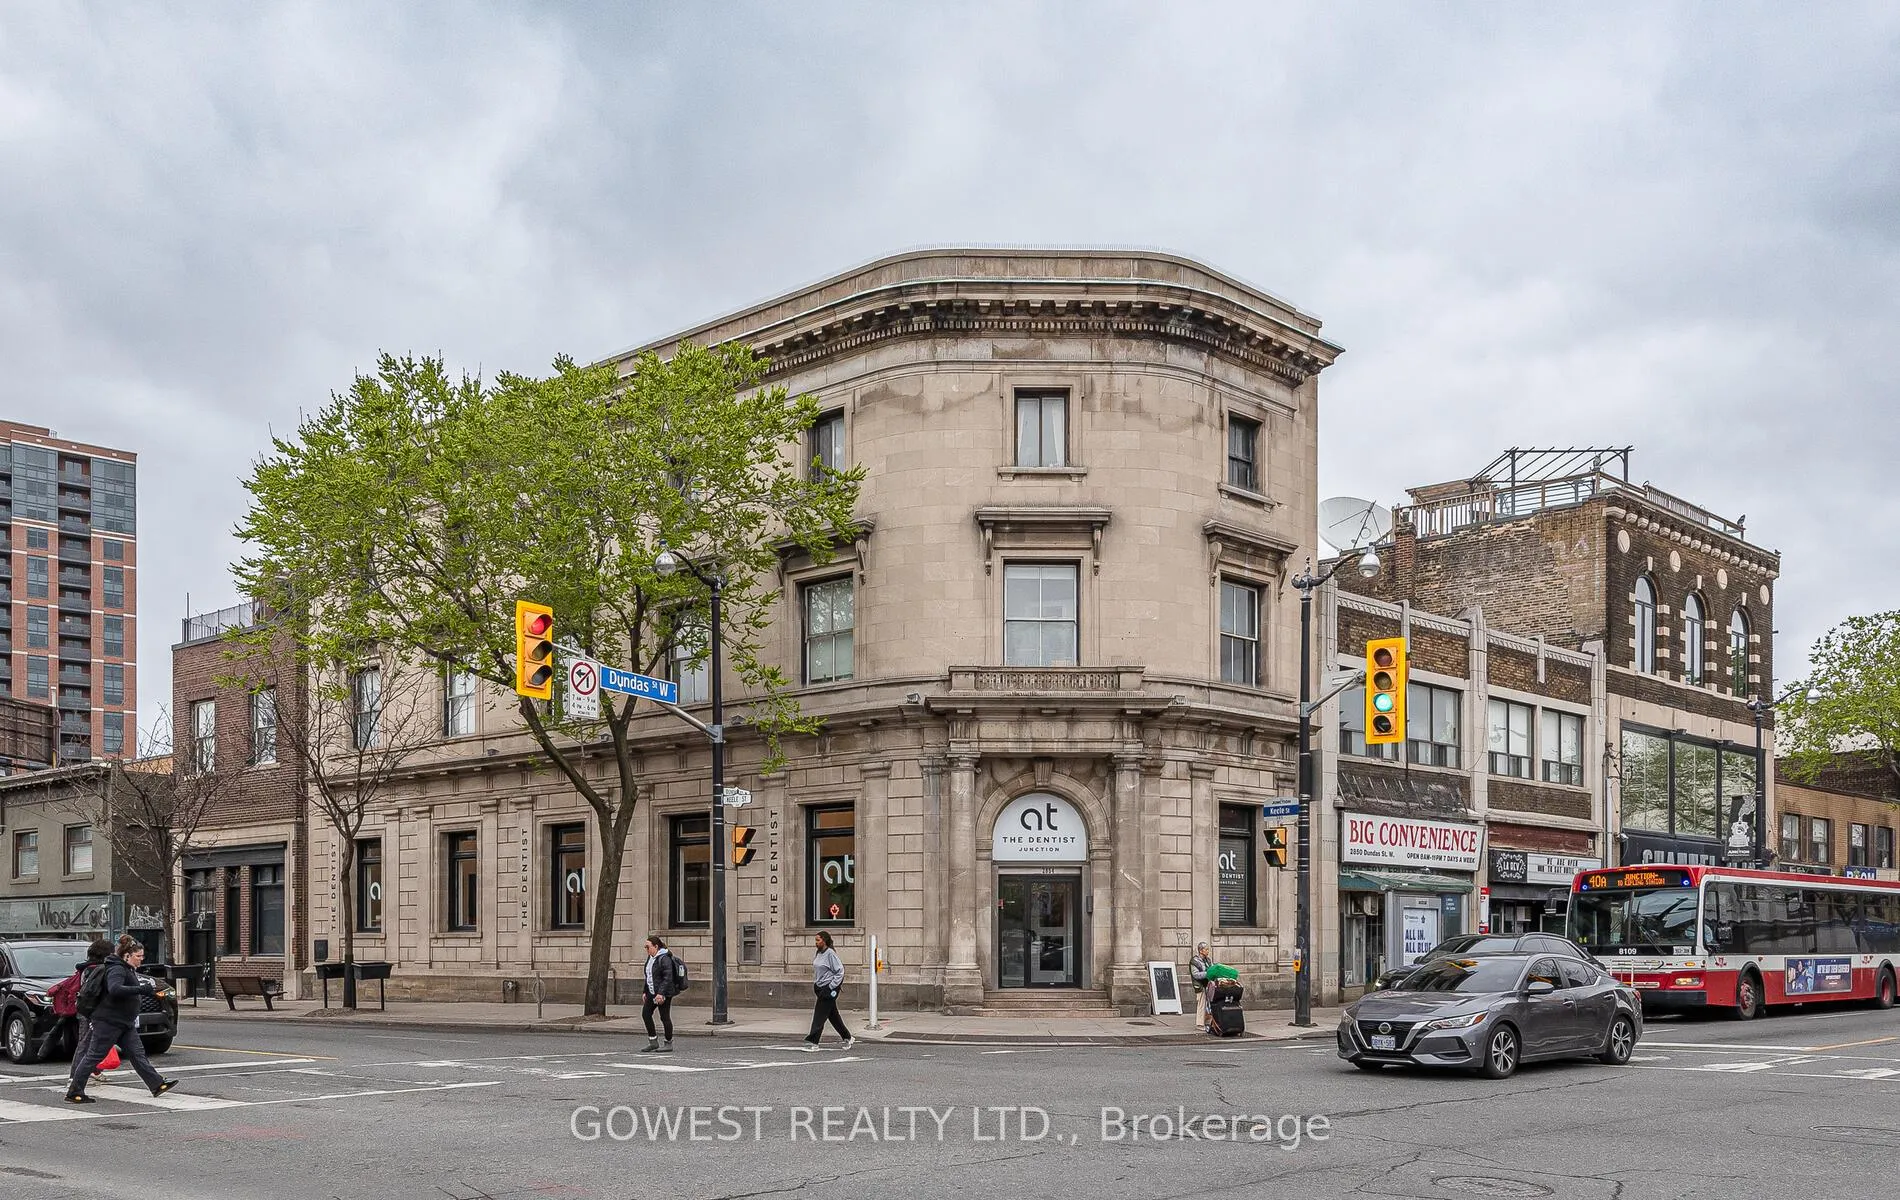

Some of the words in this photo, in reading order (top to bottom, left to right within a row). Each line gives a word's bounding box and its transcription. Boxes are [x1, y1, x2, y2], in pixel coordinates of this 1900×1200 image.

[609, 670, 649, 693] Dundas
[651, 680, 658, 689] St
[659, 682, 669, 697] W
[1270, 807, 1285, 815] Keele
[1028, 836, 1076, 844] DENTIST
[1349, 819, 1375, 845] BIG
[1379, 822, 1478, 853] CONVENIENCE
[770, 810, 778, 884] DENTIST
[1363, 849, 1381, 857] Dundas
[1406, 852, 1420, 860] OPEN
[1447, 855, 1459, 863] DAYS
[1463, 856, 1476, 864] WEEK
[1589, 875, 1607, 888] 40A
[1646, 878, 1665, 886] STATION
[770, 894, 778, 926] THE
[1405, 929, 1416, 941] ALL
[1405, 942, 1416, 953] ALL
[1618, 947, 1637, 955] 8109
